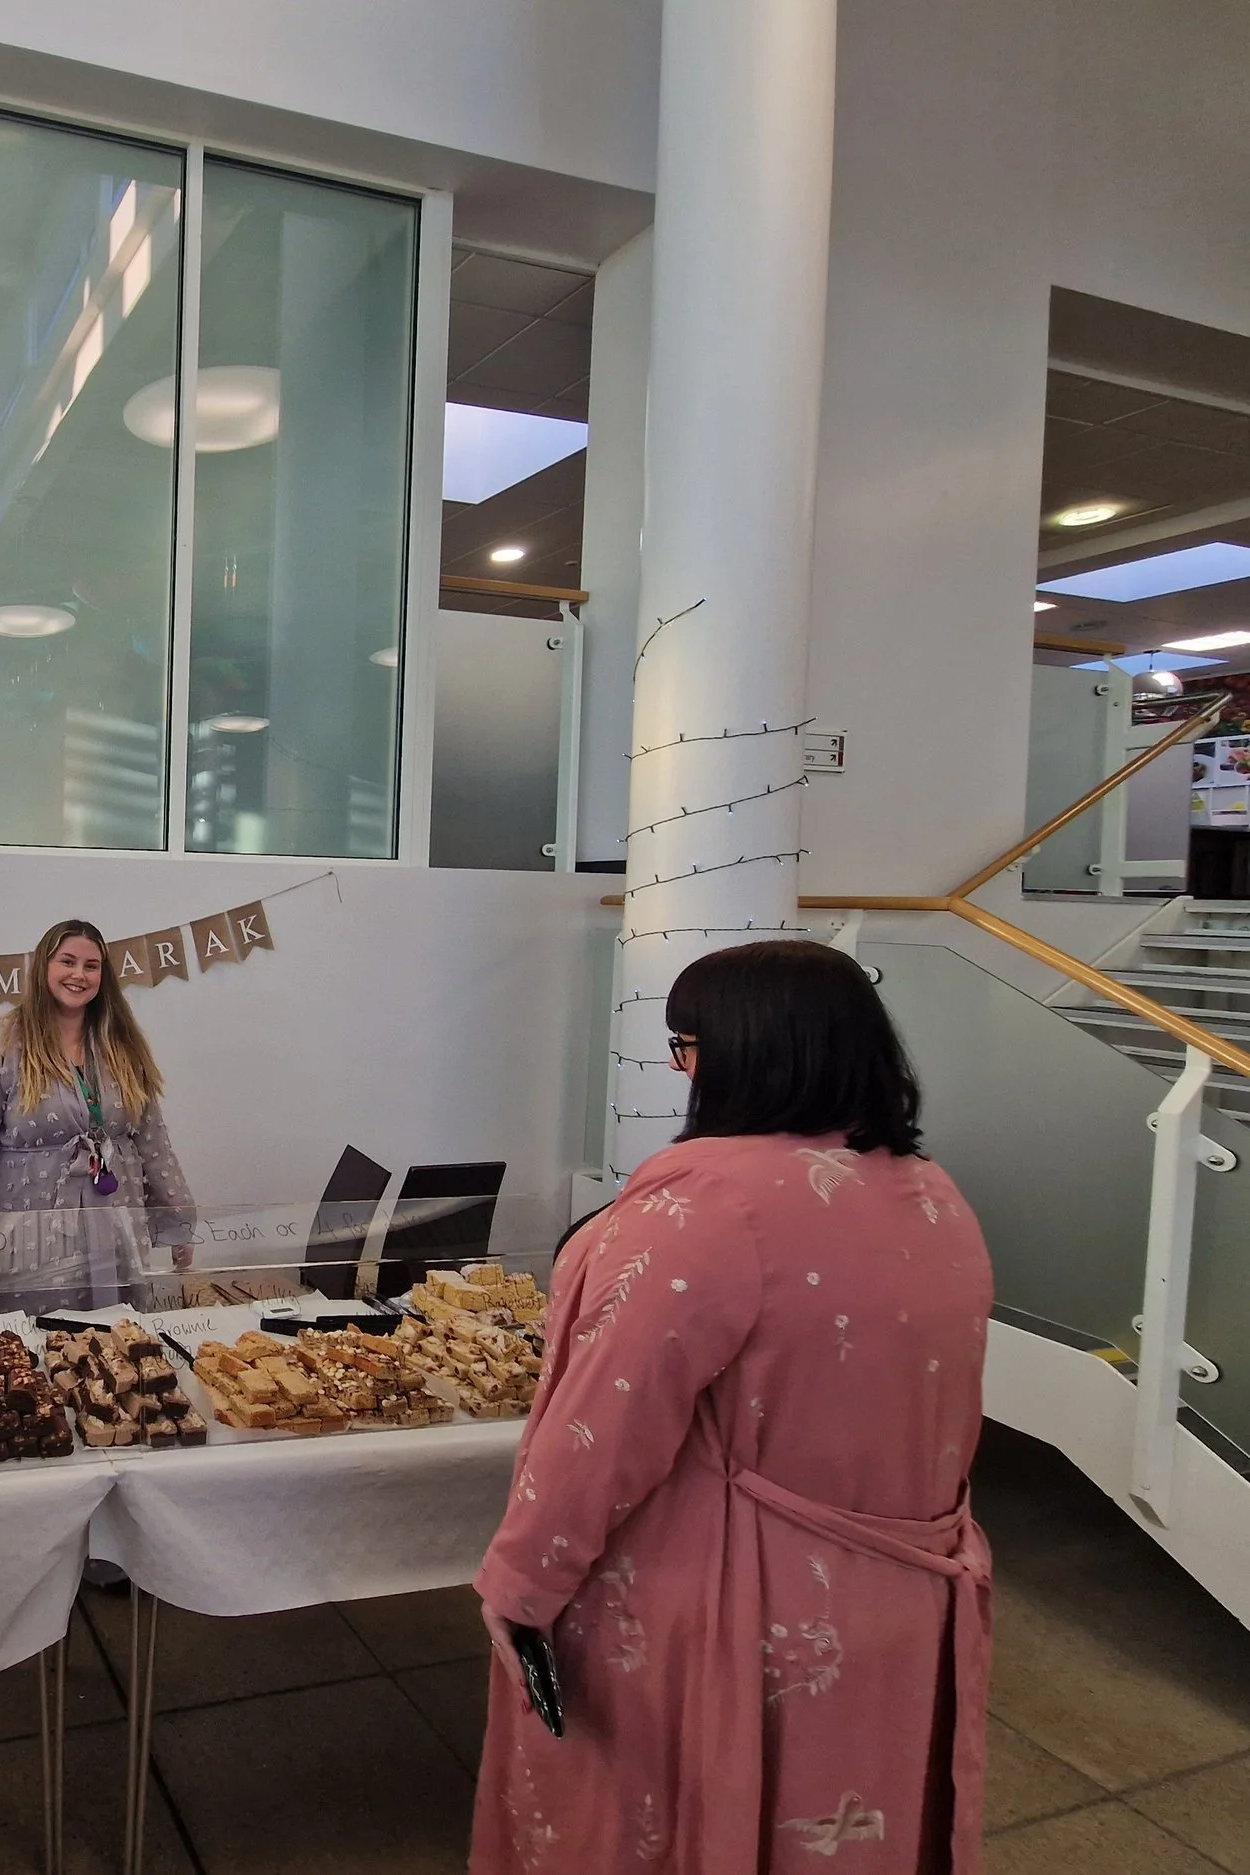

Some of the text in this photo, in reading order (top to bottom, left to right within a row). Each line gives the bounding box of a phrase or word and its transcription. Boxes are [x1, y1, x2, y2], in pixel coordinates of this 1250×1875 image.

[209, 1218, 264, 1244] Each
[275, 1220, 299, 1239] or
[151, 1314, 218, 1342] Brownie
